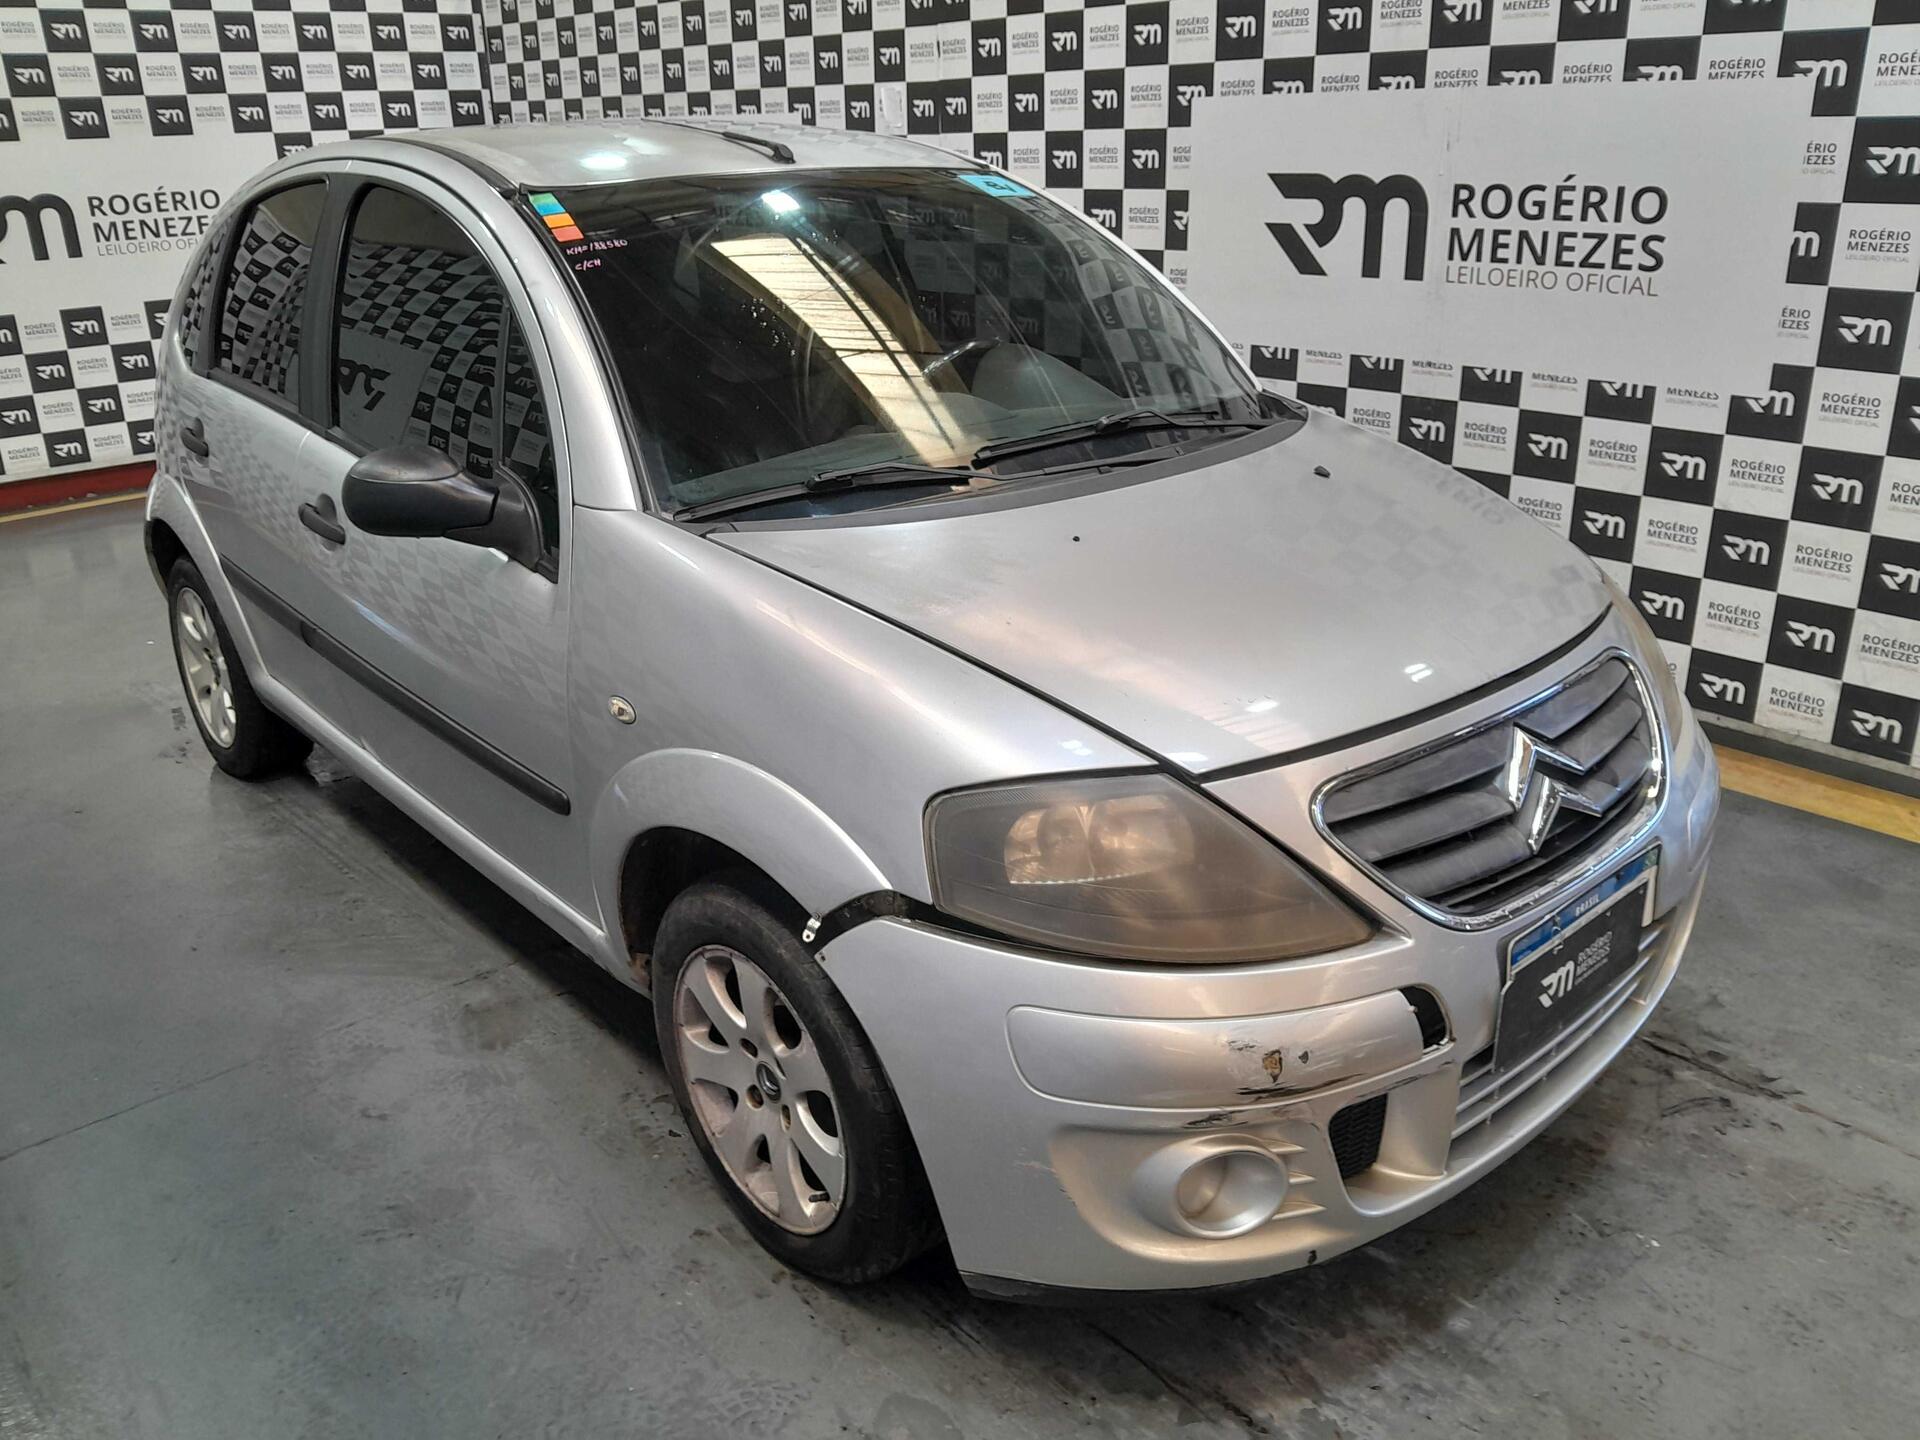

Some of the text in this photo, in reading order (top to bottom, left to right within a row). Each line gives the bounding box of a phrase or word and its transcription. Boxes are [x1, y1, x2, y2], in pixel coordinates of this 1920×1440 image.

[1272, 8, 1309, 18] ROGÉRIO
[1176, 16, 1209, 26] ROGÉRIO
[1272, 18, 1309, 28] MENEZES
[1176, 26, 1208, 36] MENEZES
[1563, 61, 1613, 75] ROGÉRIO
[1709, 56, 1766, 71] ROGÉRIO
[1321, 74, 1360, 85] ROGÉRIO
[1435, 69, 1478, 80] ROGÉRIO
[1220, 79, 1255, 90] ROGÉRIO
[87, 186, 220, 217] ROGÉRIO
[1451, 174, 1669, 224] ROGÉRIO
[92, 215, 210, 243] MENEZE
[1849, 227, 1911, 242] ROGÉRIO
[97, 240, 172, 256] LEILOEIRO
[1447, 228, 1666, 272] MENEZES
[1847, 240, 1910, 254] MENEZES
[1445, 266, 1659, 297] LEILOEIRO OFICIAL
[1822, 392, 1881, 408] ROGÉRIO
[1353, 407, 1390, 419] ROGÉRIO
[1820, 404, 1880, 419] MENEZES
[1352, 416, 1390, 428] MENEZES
[1464, 422, 1507, 435] ROGÉRIO
[1464, 431, 1506, 444] MENEZES
[1590, 438, 1638, 453] ROGÉRIO
[1588, 450, 1636, 464] MENEZES
[1731, 458, 1786, 474] ROGÉRIO
[1729, 469, 1784, 485] MENEZES
[1518, 496, 1562, 512] ROGÉRIO
[1648, 520, 1698, 535] ROGÉRIO
[1647, 529, 1698, 545] MENEZES
[1796, 544, 1853, 562] ROGÉRIO
[1794, 555, 1852, 574] MENEZES
[1709, 602, 1760, 620] ROGÉRIO
[1706, 611, 1760, 630] MENEZES
[1862, 634, 1920, 654] ROGÉRIO
[1860, 644, 1920, 665] MENEZES
[1771, 687, 1825, 708] ROGÉRIO
[1769, 697, 1824, 718] MENEZES
